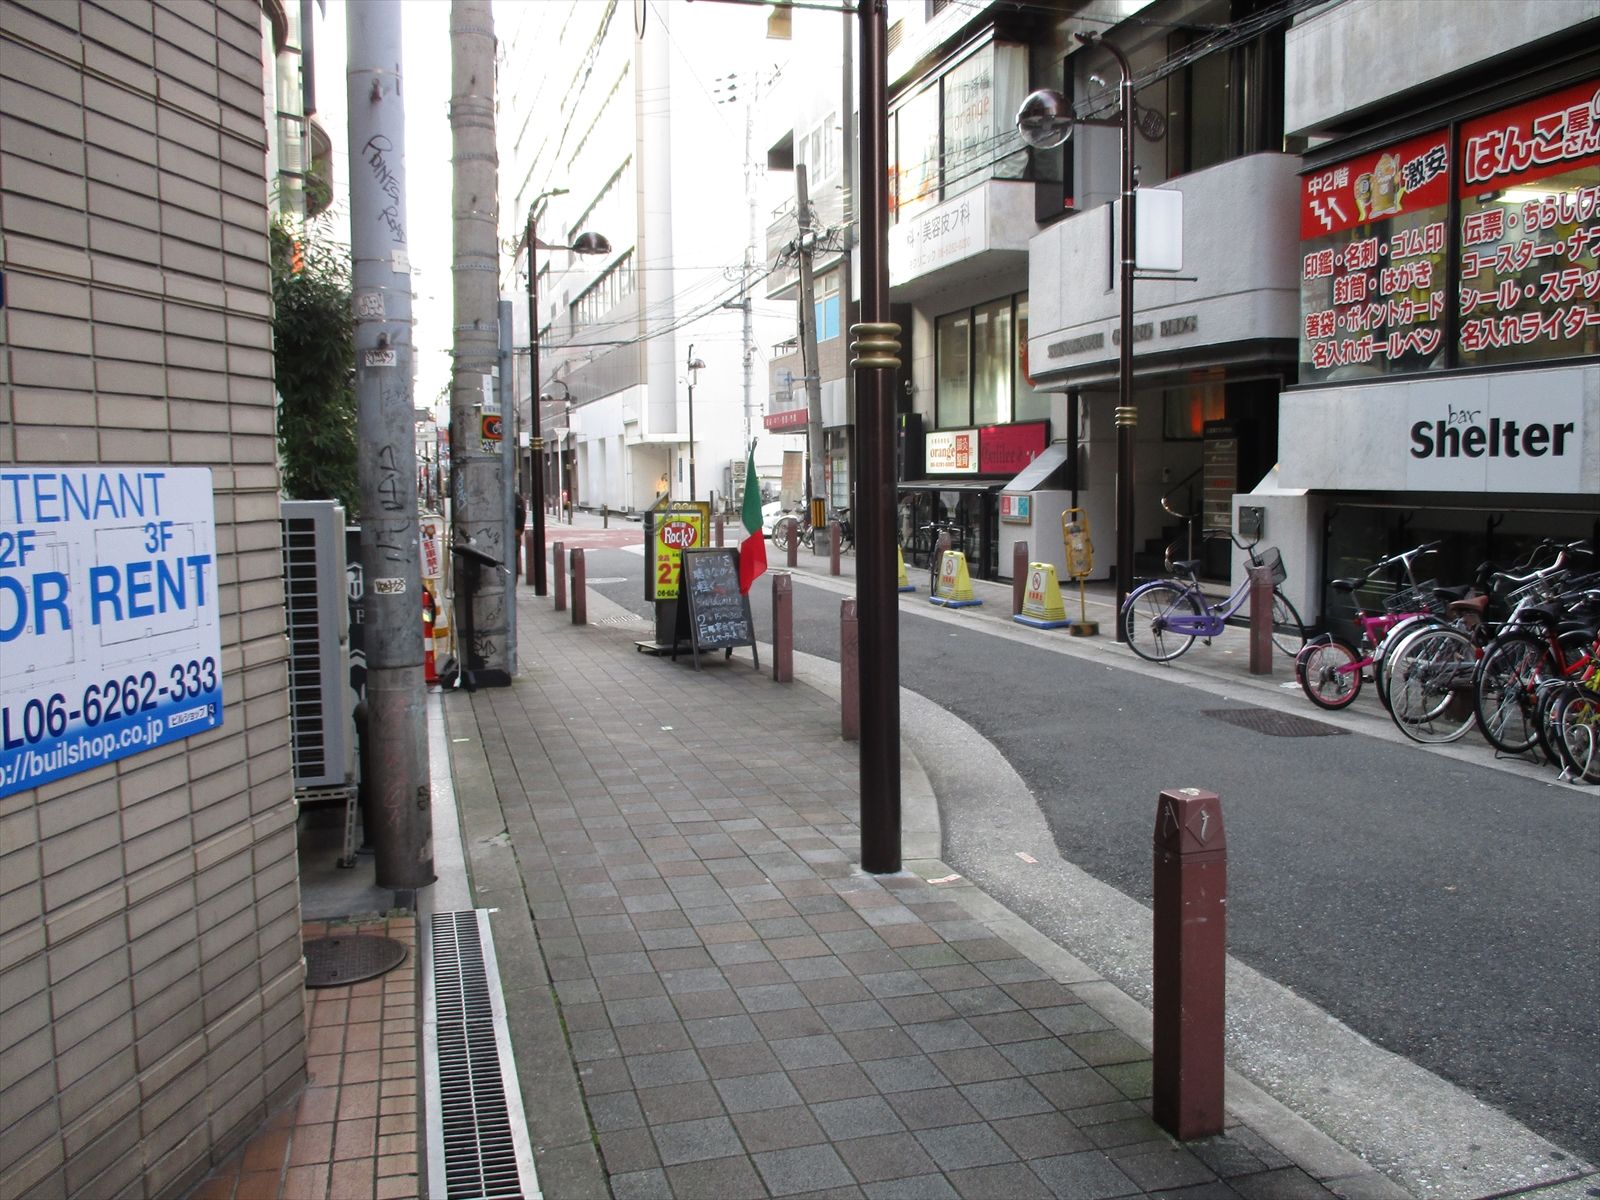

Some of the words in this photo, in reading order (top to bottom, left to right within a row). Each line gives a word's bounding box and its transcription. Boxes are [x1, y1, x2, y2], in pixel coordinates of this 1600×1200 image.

[1307, 166, 1350, 196] 中2階
[1401, 144, 1447, 192] 激安
[1462, 186, 1600, 248] 伝票・ちらし(フ
[1303, 223, 1445, 280] 印鑑・名刺・ゴム印
[1333, 261, 1433, 305] 封筒・はがき
[1305, 291, 1445, 340] 箸袋・ポイントカード
[1312, 328, 1441, 370] 名入れボールペン
[1448, 404, 1481, 425] bar
[930, 446, 956, 461] orange
[1409, 417, 1575, 459] Shelter
[0, 473, 165, 524] TENANT
[144, 520, 174, 554] 3F
[89, 554, 212, 625] RENT
[170, 707, 205, 727] ビルショップ
